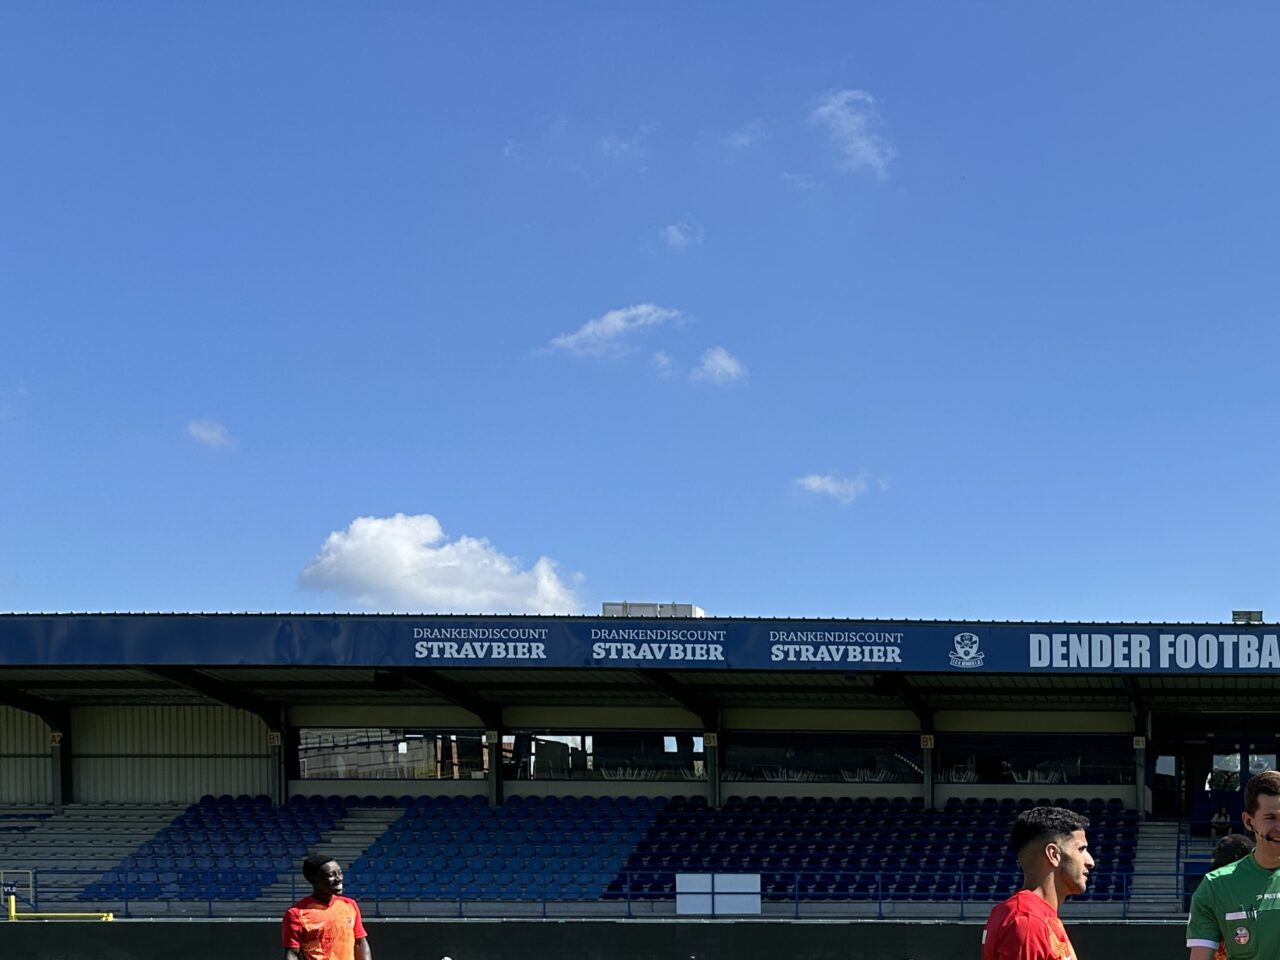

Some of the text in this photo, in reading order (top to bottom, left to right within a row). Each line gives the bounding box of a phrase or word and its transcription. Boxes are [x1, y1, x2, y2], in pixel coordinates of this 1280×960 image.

[413, 628, 548, 638] DRANKENDISCOUNT
[591, 629, 726, 640] DRANKENDISCOUNT
[769, 631, 904, 643] DRANKENDISCOUNT
[415, 642, 547, 658] STRAVBIER
[592, 643, 725, 660] STRAVBIER
[771, 645, 902, 662] STRAVBIER
[1030, 634, 1151, 668] DENDER
[268, 734, 280, 745] B1
[704, 734, 716, 745] B1
[921, 736, 932, 747] B1
